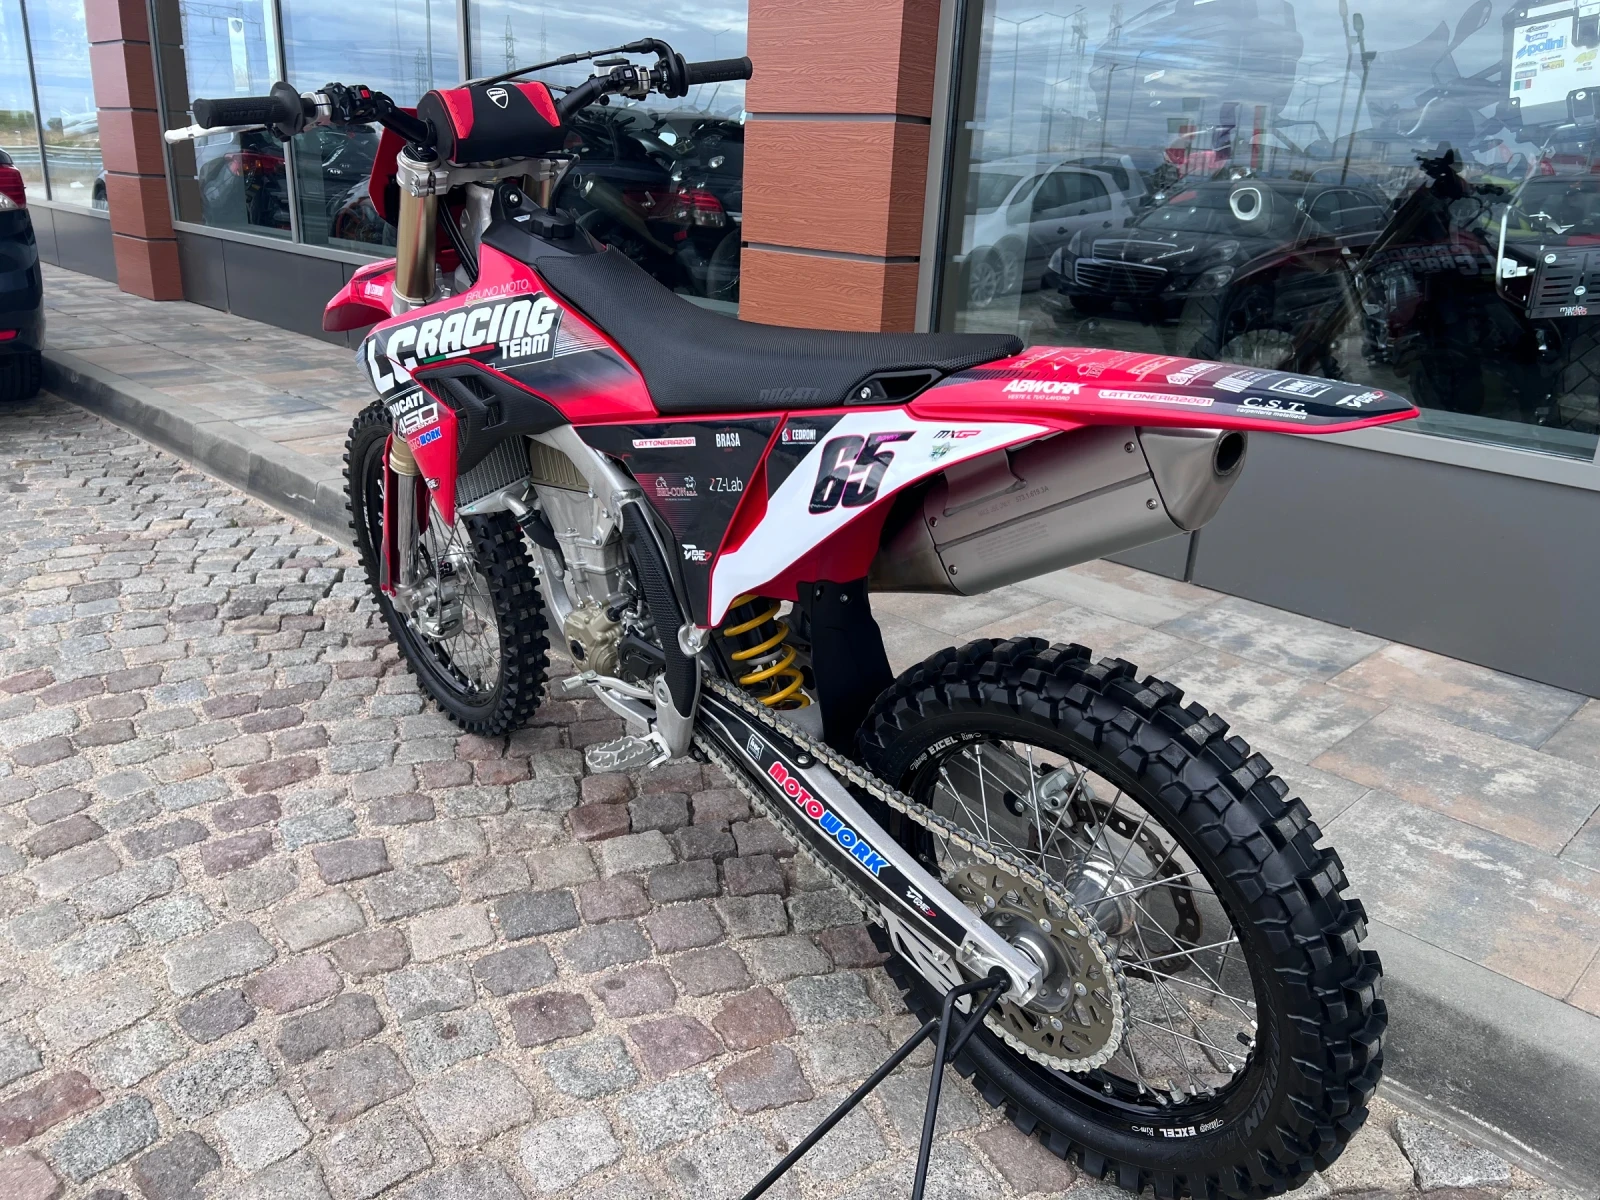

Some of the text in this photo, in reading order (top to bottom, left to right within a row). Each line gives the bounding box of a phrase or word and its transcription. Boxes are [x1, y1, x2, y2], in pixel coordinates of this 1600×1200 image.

[466, 279, 529, 300] BRUNO MOTO
[416, 296, 559, 359] RACING
[499, 334, 550, 360] TEAM
[1002, 379, 1088, 395] ABWORK
[389, 390, 424, 418] DUCATI
[1243, 397, 1306, 413] C.S.T.
[408, 425, 443, 452] OTOWORK
[715, 432, 741, 448] BRASA
[808, 430, 917, 515] 65
[927, 736, 958, 756] EXCEL
[767, 760, 892, 878] MOTOWORK
[1159, 1126, 1198, 1138] EXCEL
